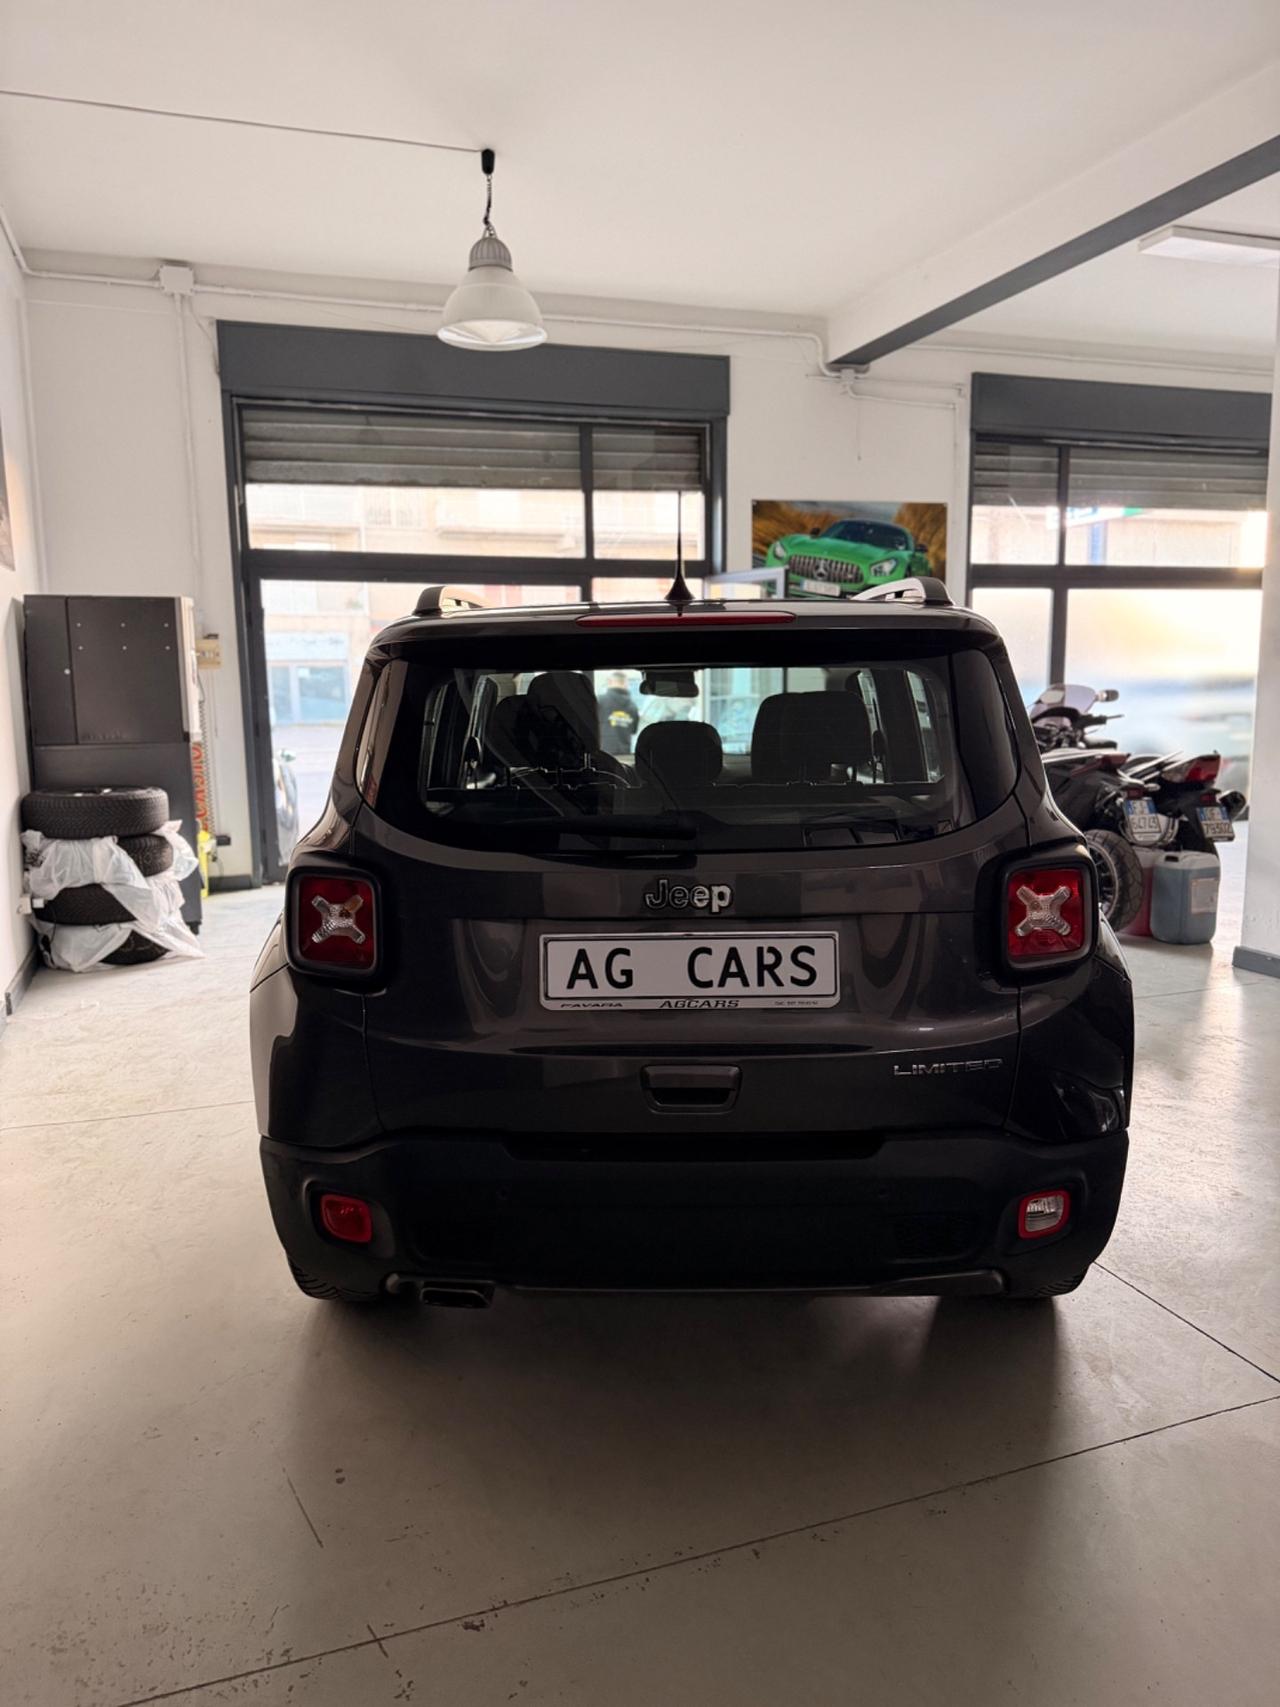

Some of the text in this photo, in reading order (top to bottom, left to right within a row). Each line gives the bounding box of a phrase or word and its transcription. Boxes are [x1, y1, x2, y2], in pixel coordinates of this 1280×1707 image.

[645, 879, 731, 913] Jeep
[566, 945, 817, 990] AG CARS
[659, 1000, 739, 1009] AGCARS
[894, 1058, 1003, 1076] LIMITED
